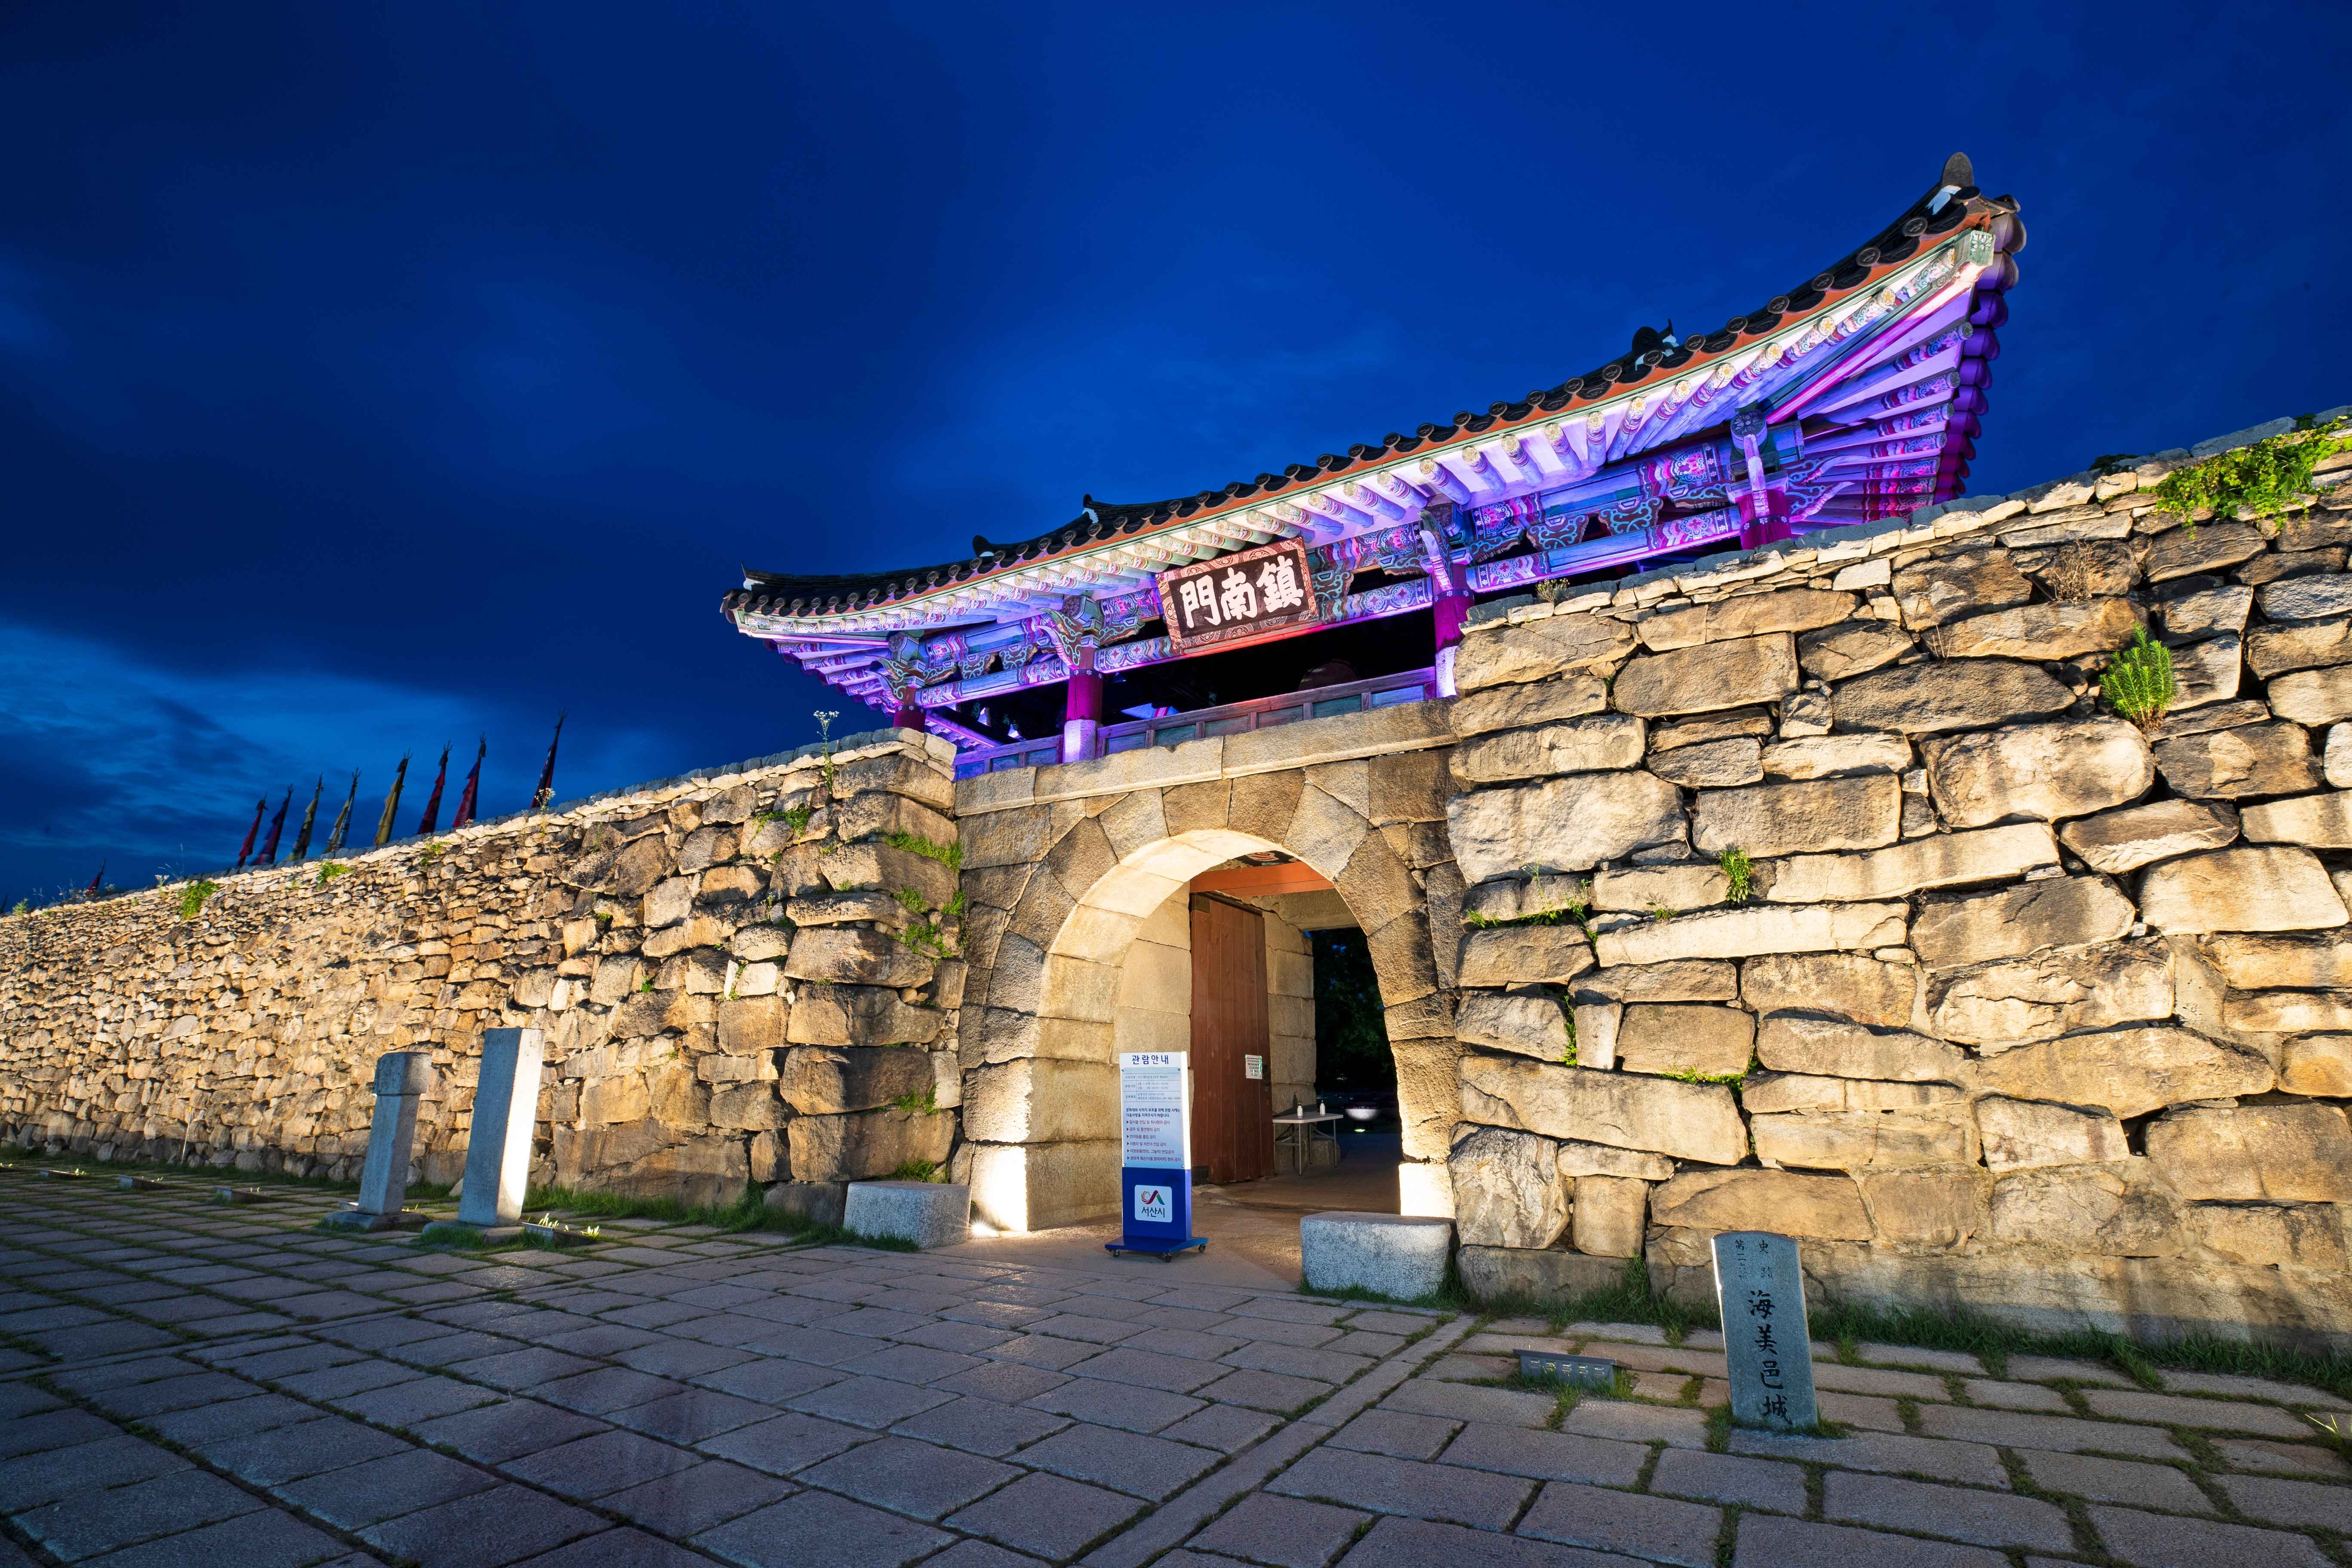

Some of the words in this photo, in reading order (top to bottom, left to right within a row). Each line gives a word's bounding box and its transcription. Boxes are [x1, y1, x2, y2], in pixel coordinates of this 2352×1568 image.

[1132, 1055, 1169, 1065] 관람안내
[1142, 1207, 1165, 1218] 서산시
[1748, 1289, 1793, 1425] 海美邑城
